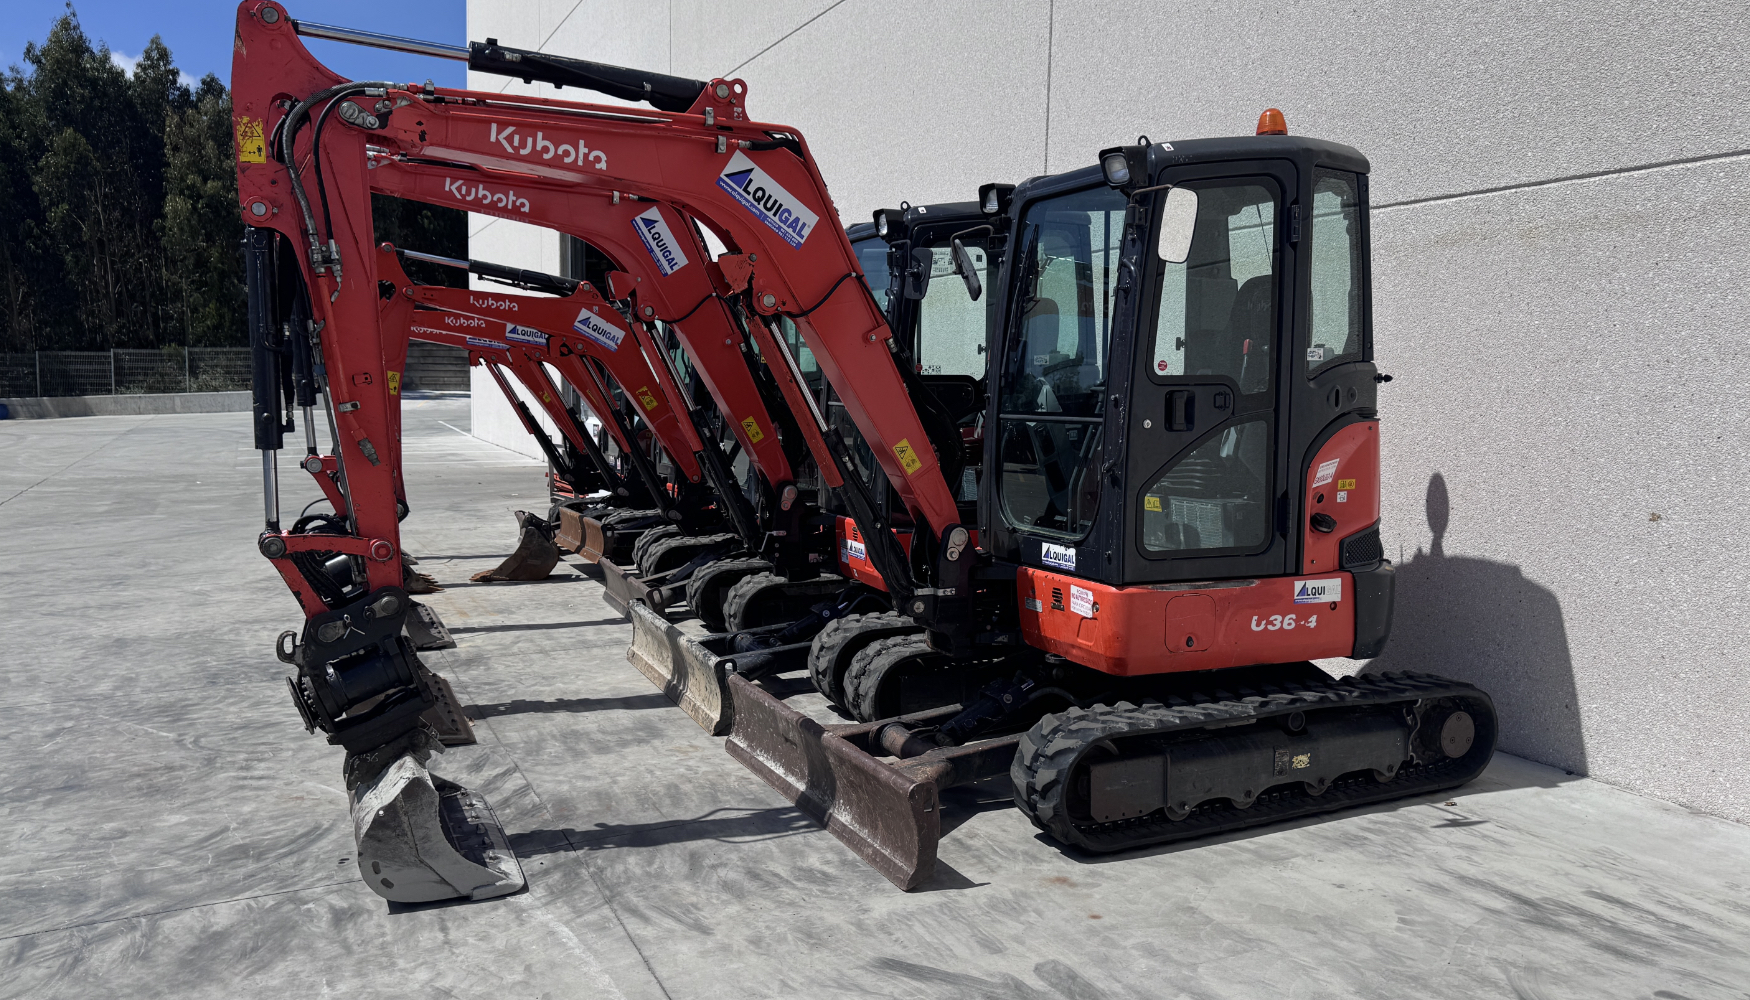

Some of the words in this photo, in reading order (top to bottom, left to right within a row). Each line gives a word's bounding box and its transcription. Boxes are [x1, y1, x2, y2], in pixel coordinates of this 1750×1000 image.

[490, 122, 607, 171] Kubota
[444, 177, 530, 213] Kubota
[469, 295, 518, 311] Kubota
[445, 316, 486, 328] Kubota
